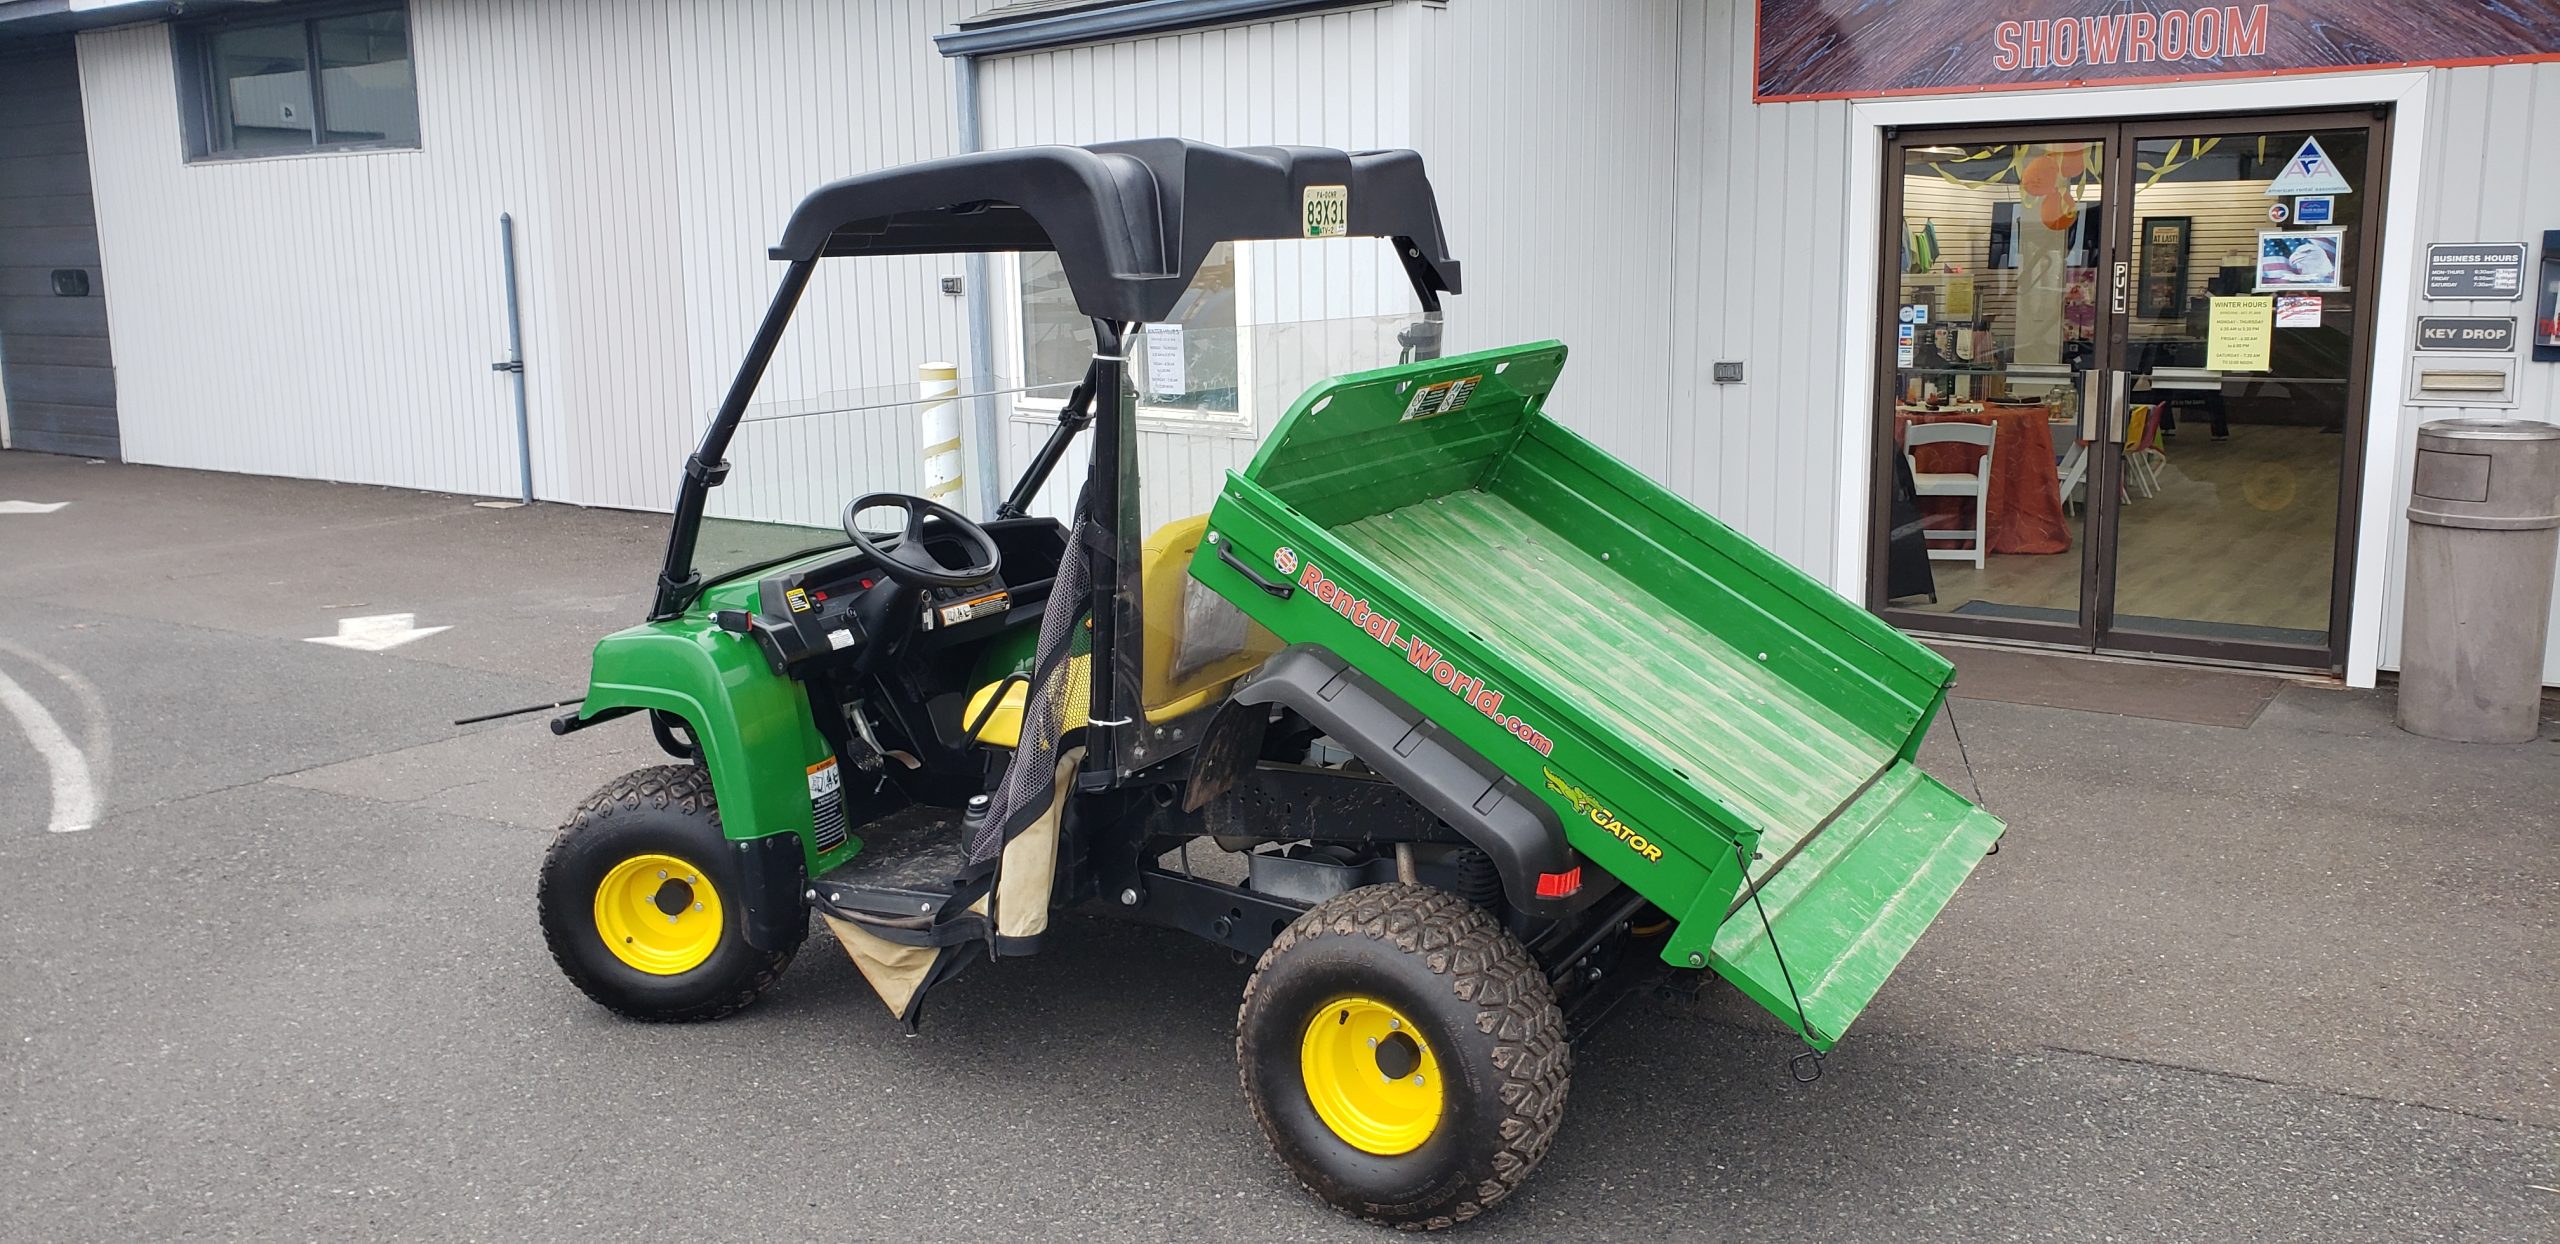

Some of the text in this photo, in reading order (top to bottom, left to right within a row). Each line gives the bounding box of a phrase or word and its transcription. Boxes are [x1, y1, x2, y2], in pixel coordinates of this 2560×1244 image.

[1993, 4, 2269, 71] SHOWROOM
[1307, 200, 1344, 225] 83X31
[2153, 234, 2178, 243] AT LAST!
[2484, 254, 2519, 262] HOURS
[2114, 265, 2126, 311] PULL
[2424, 328, 2507, 339] KEY DROP
[1298, 562, 1553, 757] Rental-World.com
[1589, 808, 1664, 864] GATOR
